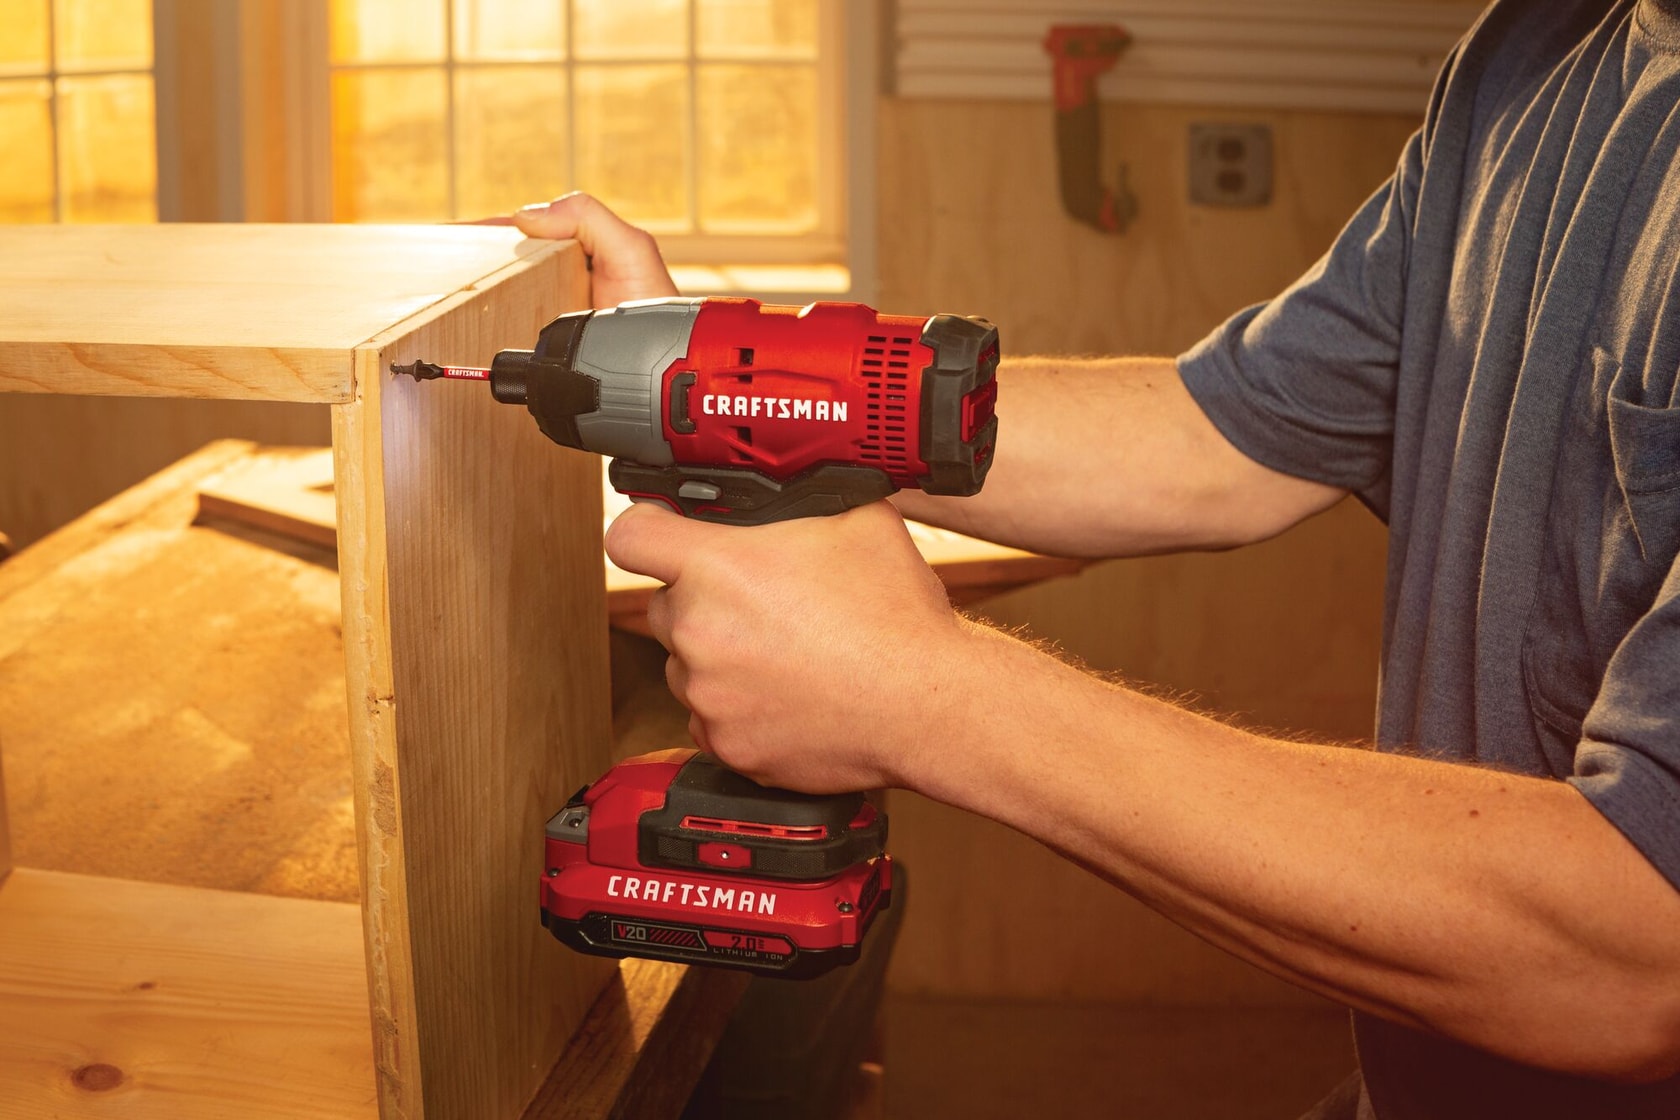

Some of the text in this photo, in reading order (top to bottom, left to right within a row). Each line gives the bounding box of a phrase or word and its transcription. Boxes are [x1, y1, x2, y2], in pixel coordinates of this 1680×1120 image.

[702, 394, 848, 422] CRAFTSMAN
[607, 875, 777, 915] CRAFTSMAN
[617, 924, 646, 941] V20
